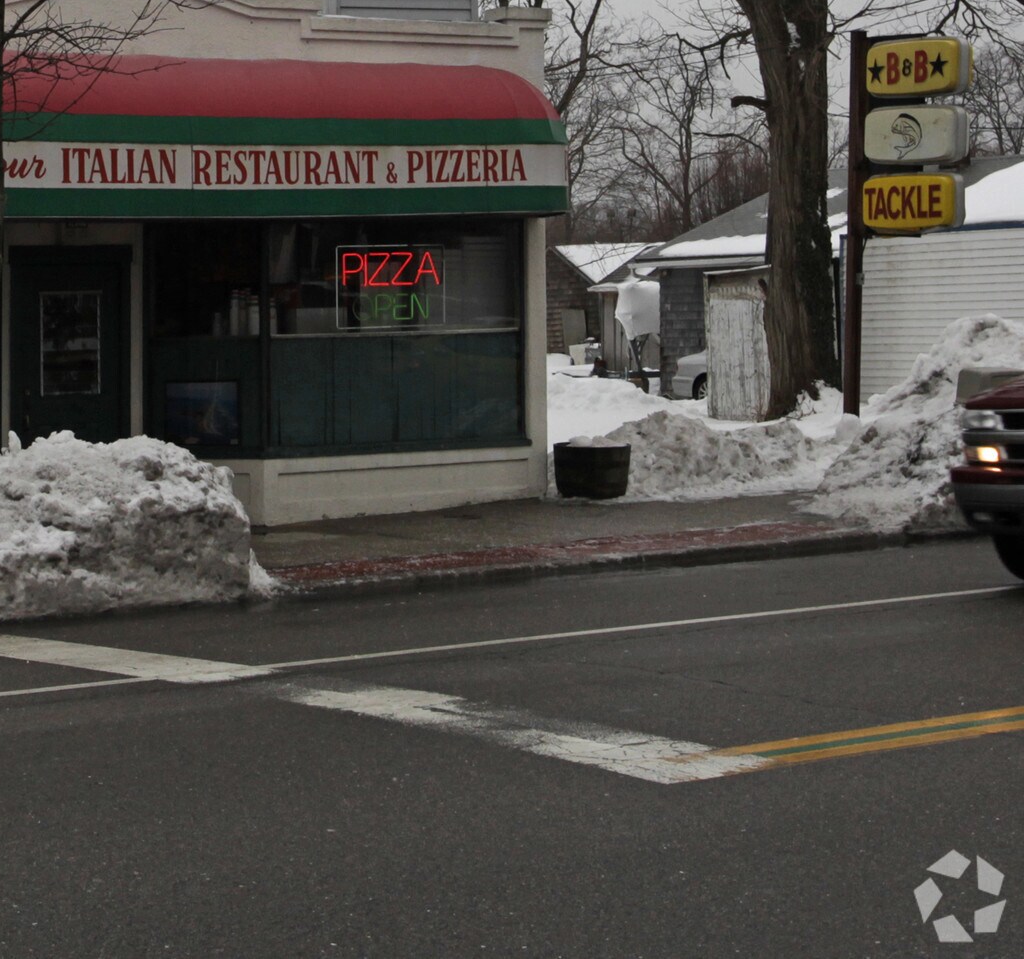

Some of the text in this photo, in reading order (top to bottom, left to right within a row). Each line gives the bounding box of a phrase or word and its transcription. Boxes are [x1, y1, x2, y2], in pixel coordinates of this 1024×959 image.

[61, 148, 176, 184] ITALIAN
[193, 150, 378, 186] RESTAURANT
[386, 162, 398, 184] &
[407, 149, 528, 184] PIZZERIA
[864, 184, 942, 220] TACKLE
[341, 251, 440, 287] PIZZA
[352, 293, 429, 321] OPEN
